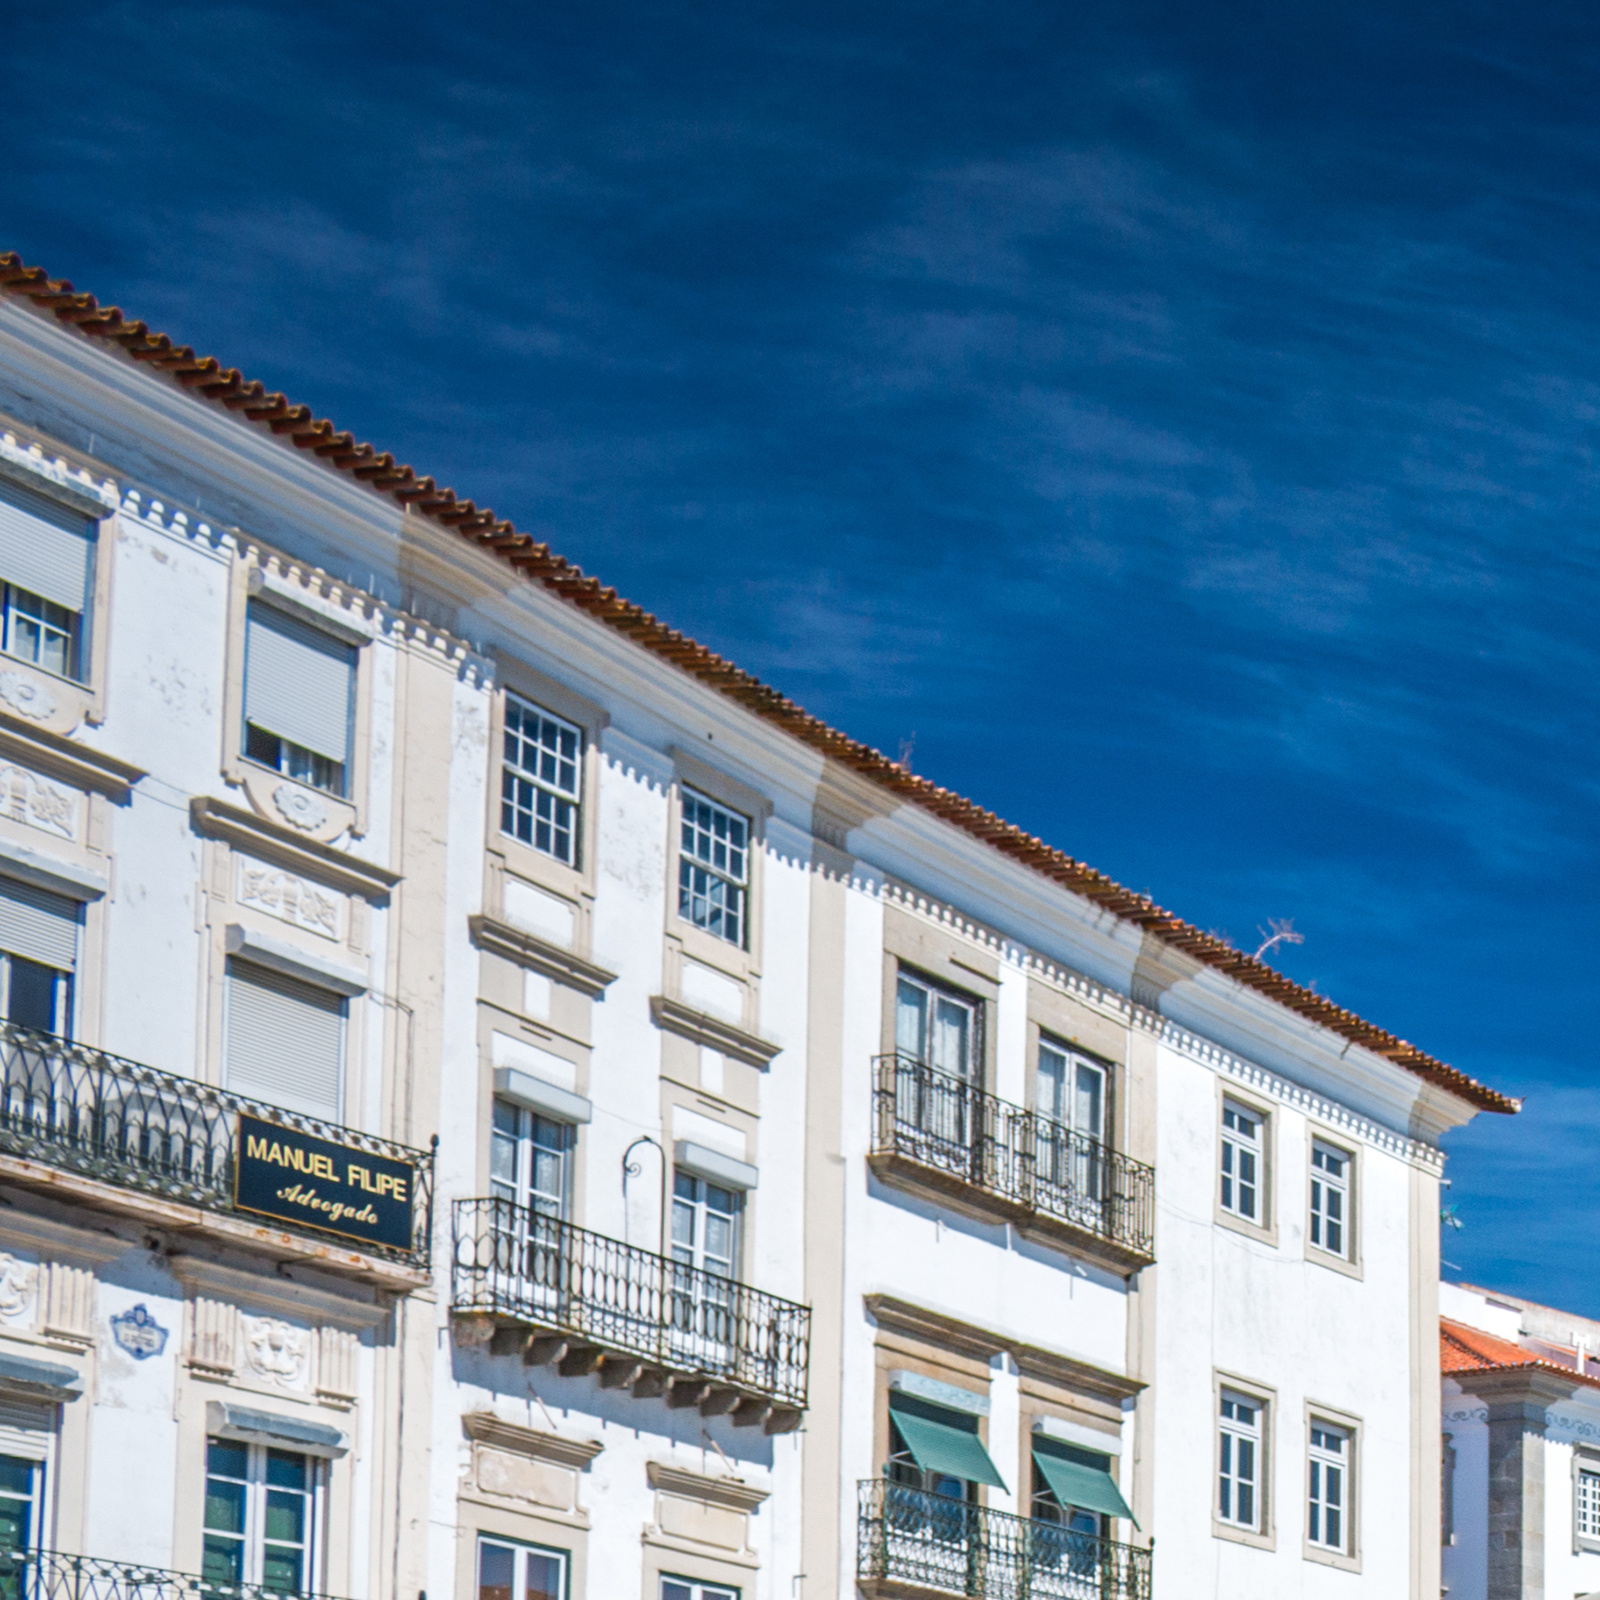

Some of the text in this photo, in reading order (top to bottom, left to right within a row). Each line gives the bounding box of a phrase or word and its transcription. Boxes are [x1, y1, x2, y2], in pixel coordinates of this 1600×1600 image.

[247, 1134, 407, 1202] MANUEL FILIPE
[276, 1184, 378, 1224] Advogado
